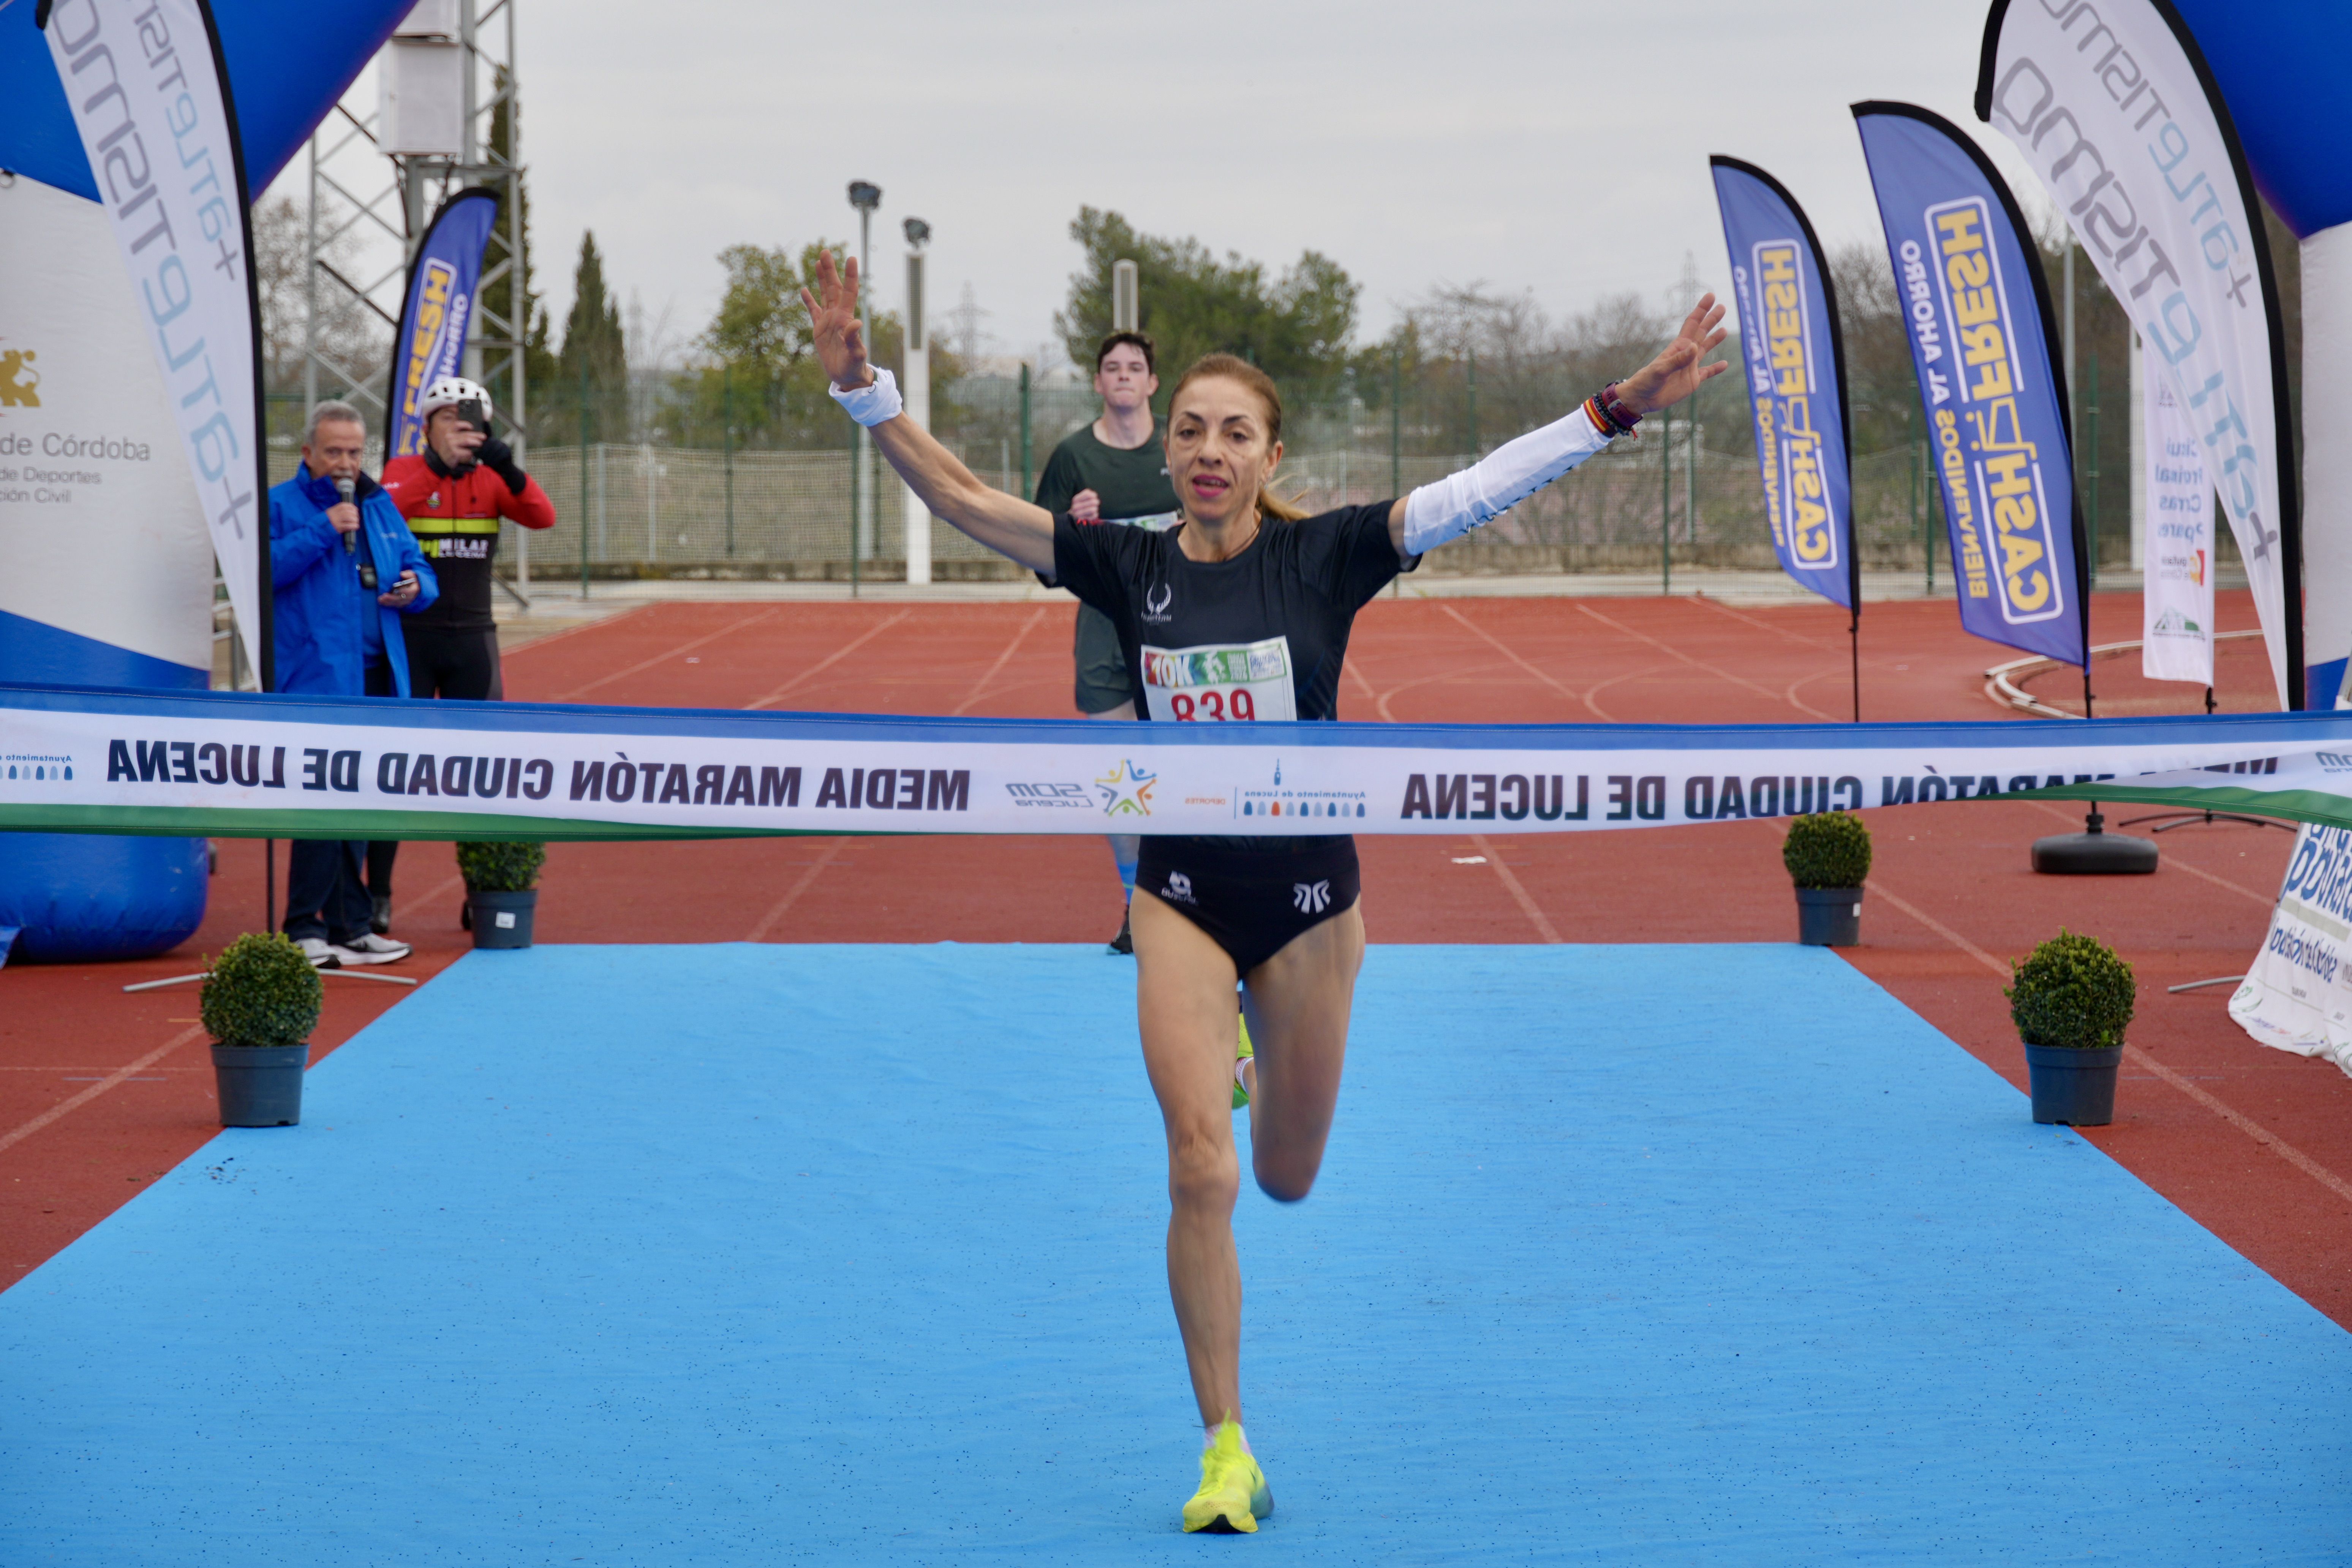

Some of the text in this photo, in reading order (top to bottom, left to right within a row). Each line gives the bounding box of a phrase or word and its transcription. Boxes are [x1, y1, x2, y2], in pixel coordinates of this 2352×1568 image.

[403, 267, 450, 416] FRESH
[0, 432, 150, 462] de Córdoba
[23, 466, 103, 485] Deportes
[34, 487, 72, 503] Civil
[1151, 654, 1194, 688] 10K
[1171, 688, 1255, 721] 839
